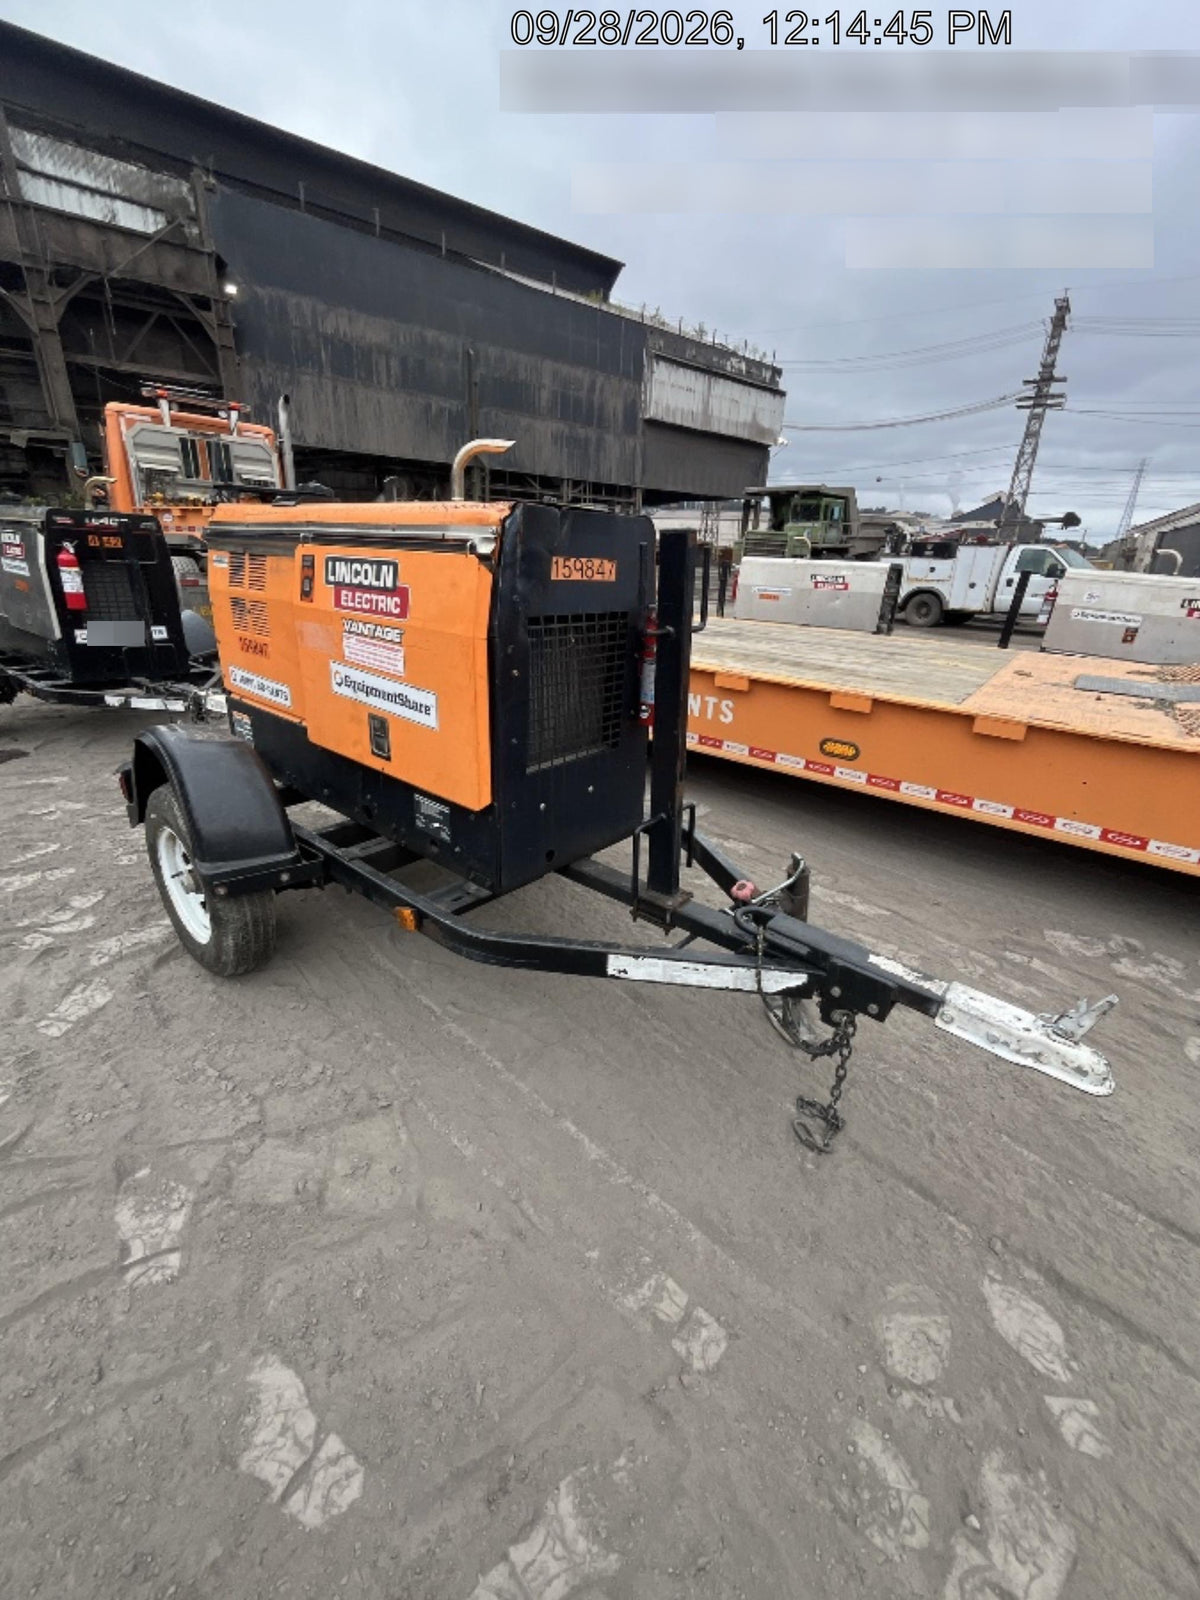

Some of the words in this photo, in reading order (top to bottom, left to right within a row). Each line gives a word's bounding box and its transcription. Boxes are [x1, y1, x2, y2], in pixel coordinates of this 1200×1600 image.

[328, 561, 394, 588] LINCOLN
[554, 557, 615, 579] 159847
[341, 590, 401, 614] ELECTRIC
[343, 618, 404, 643] VANTAGE
[344, 675, 431, 715] EquipmentShare
[688, 693, 734, 724] NTS
